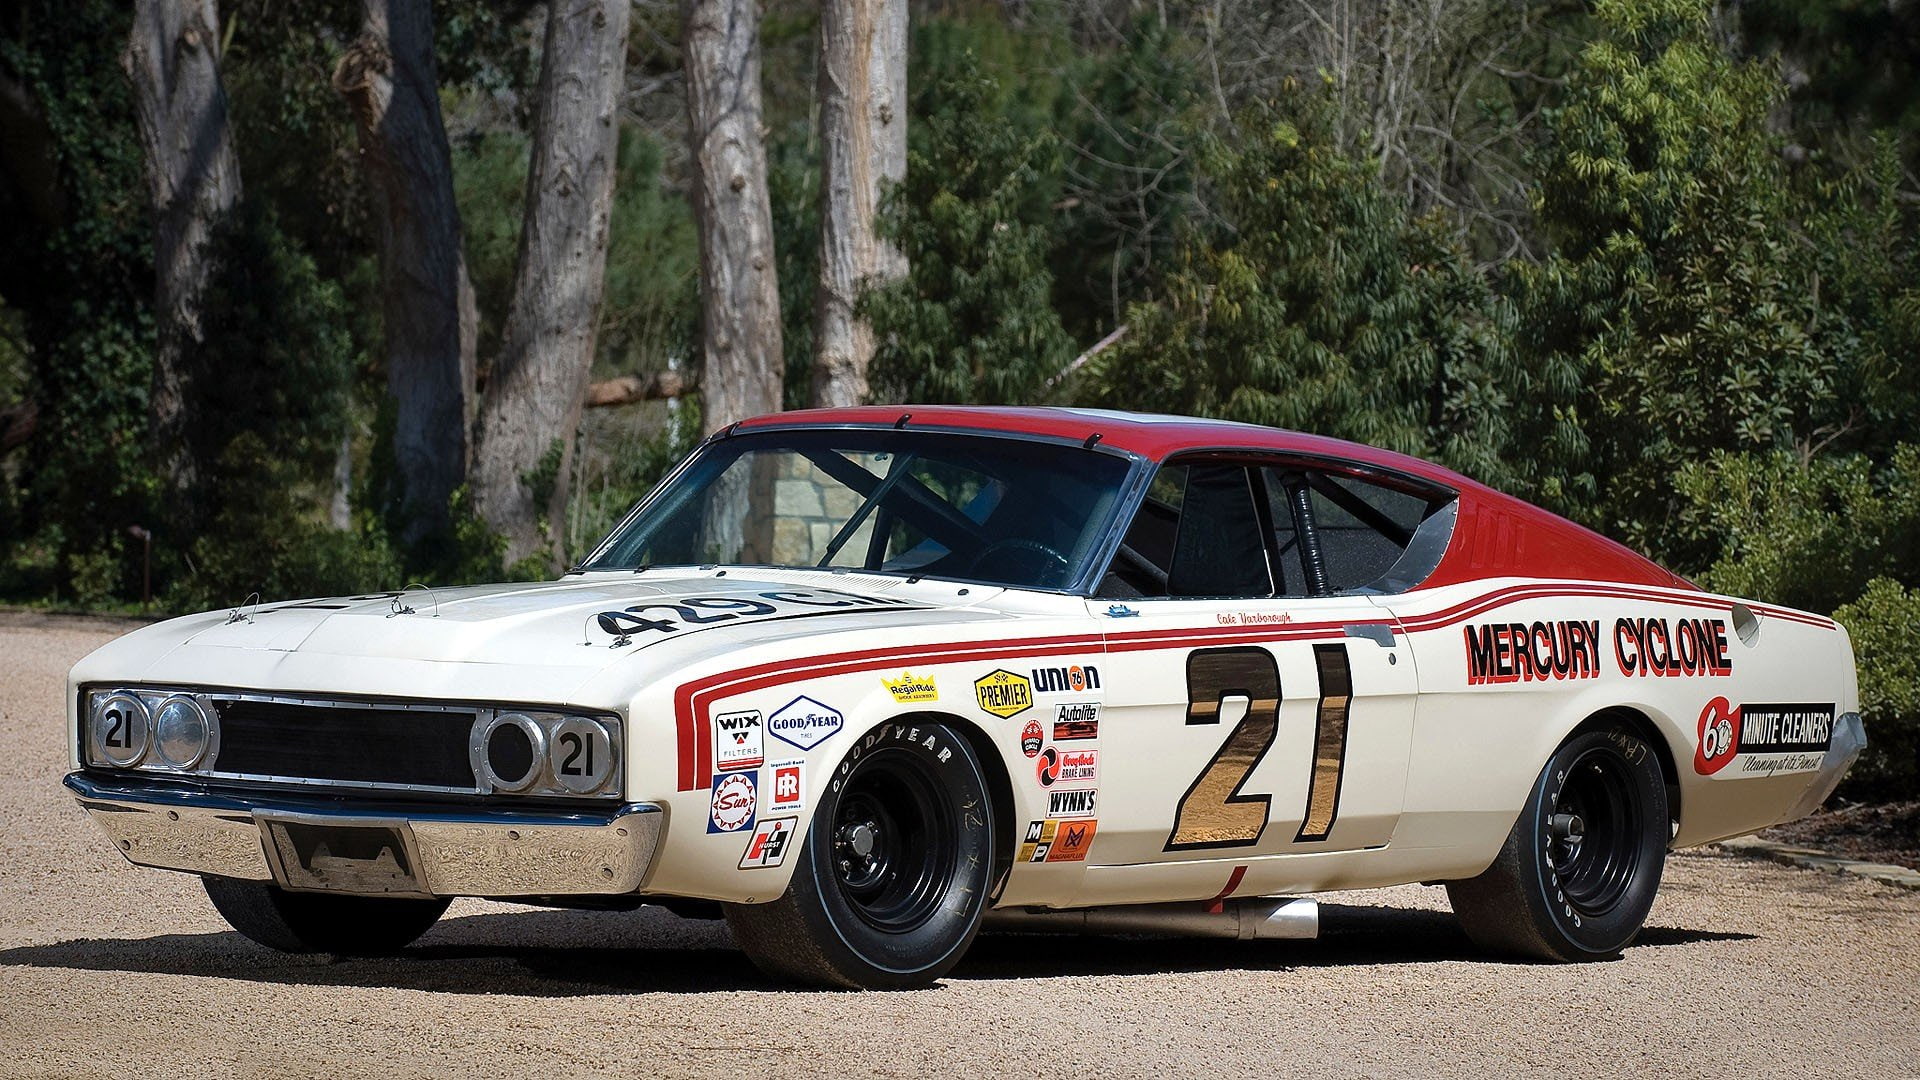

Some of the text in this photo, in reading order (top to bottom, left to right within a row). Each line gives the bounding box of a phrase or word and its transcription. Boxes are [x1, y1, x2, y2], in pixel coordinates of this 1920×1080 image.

[598, 597, 777, 636] 429
[1216, 612, 1237, 625] Cale
[1464, 617, 1733, 685] MERCURY CYCLONE
[980, 683, 1029, 707] PREMIER
[719, 715, 761, 731] WIX
[773, 713, 839, 731] GOODYEAR
[1058, 703, 1097, 722] Autolite
[104, 708, 133, 749] 21
[1741, 711, 1831, 745] MINUTE CLEANERS
[559, 730, 596, 778] 21
[722, 747, 759, 758] FILTERS
[831, 722, 953, 793] GOODYEAR
[1162, 643, 1354, 852] 21
[718, 792, 750, 811] Sun
[1049, 790, 1096, 813] WYNN'S
